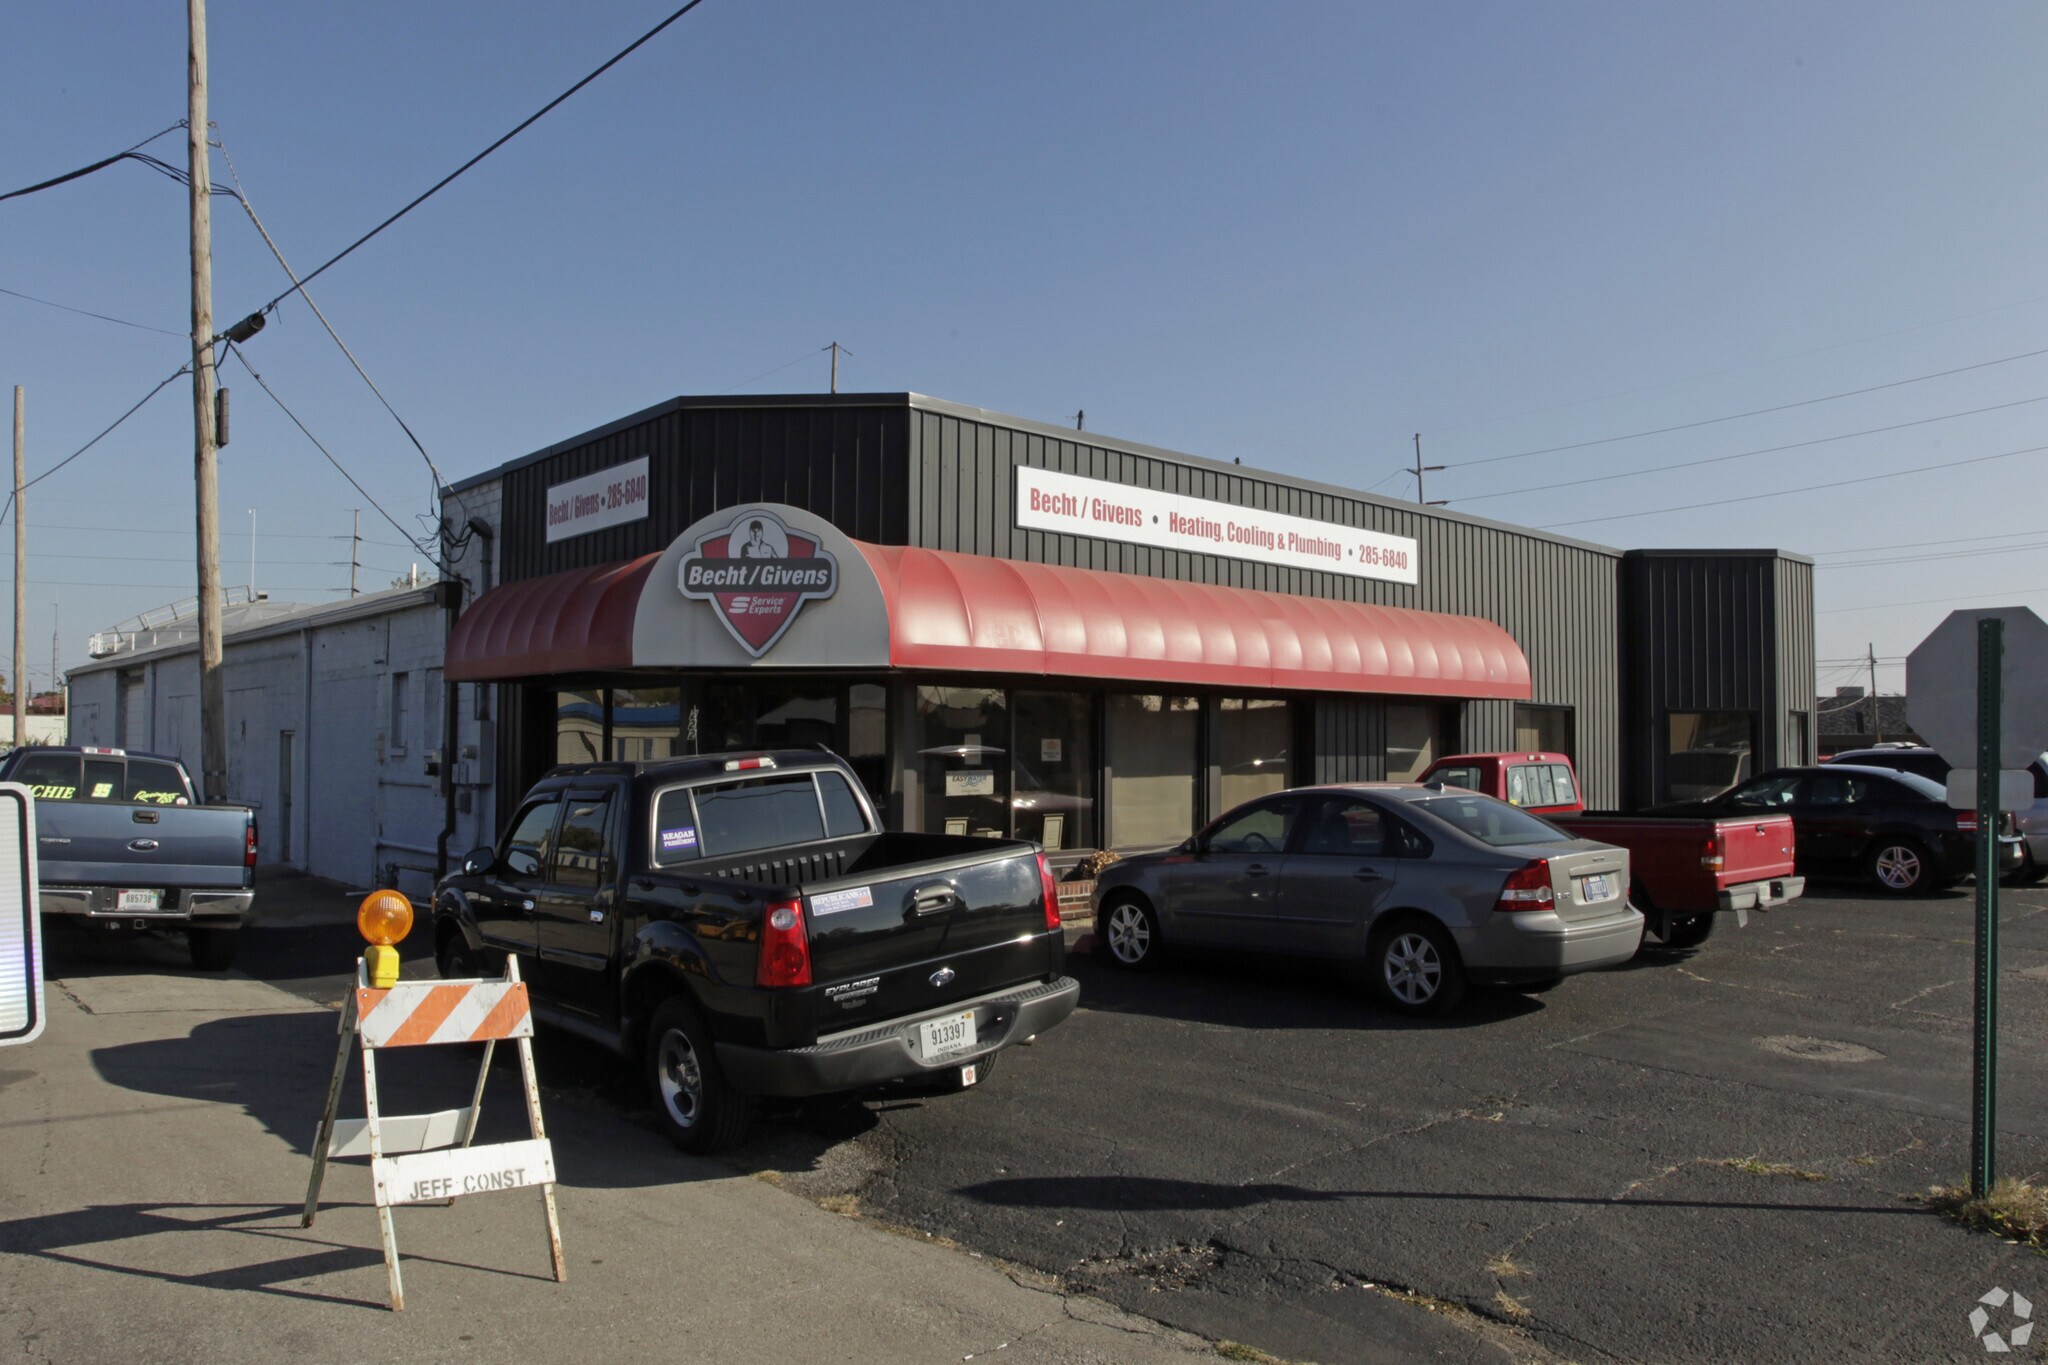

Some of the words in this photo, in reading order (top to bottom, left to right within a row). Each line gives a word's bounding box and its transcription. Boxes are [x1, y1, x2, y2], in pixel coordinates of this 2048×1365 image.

[549, 500, 569, 527] Becht
[575, 493, 600, 518] Givens
[607, 474, 646, 510] 285-6840
[1030, 487, 1078, 518] Becht
[1092, 498, 1143, 528] Givens
[1169, 511, 1224, 543] Heating,
[1227, 521, 1275, 551] Cooling
[1277, 533, 1286, 550] &
[1288, 532, 1342, 561] Plumbing
[1359, 544, 1408, 570] 285-6840
[749, 605, 782, 616] Experts
[751, 596, 785, 606] Service
[662, 829, 694, 840] REAGAN
[825, 977, 880, 996] EXPLORER
[931, 1022, 965, 1045] 913397
[938, 1042, 962, 1053] INDIANA
[409, 1178, 453, 1200] JEFF
